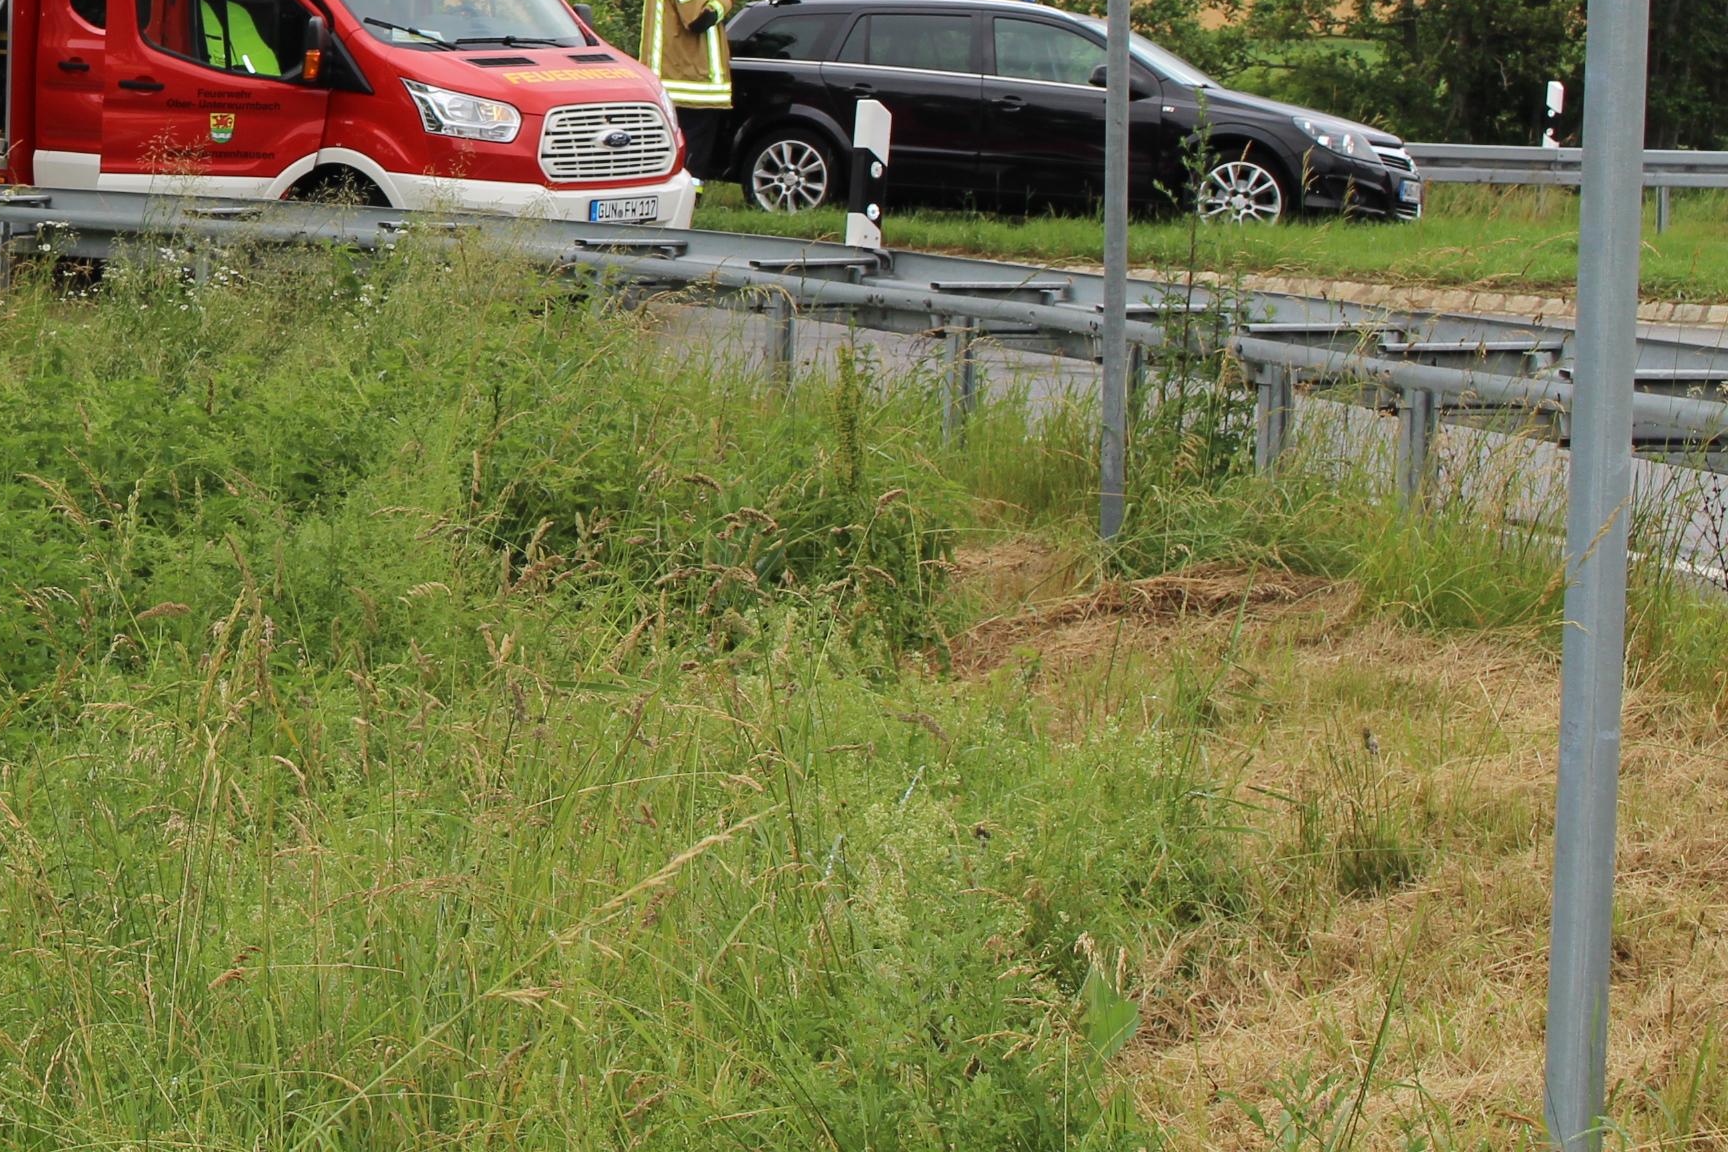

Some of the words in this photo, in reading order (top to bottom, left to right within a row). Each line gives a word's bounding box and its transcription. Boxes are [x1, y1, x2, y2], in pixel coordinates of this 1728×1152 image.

[502, 68, 643, 85] FEUERWEHR
[197, 88, 252, 99] Feuerwehr
[598, 201, 618, 219] GUN
[624, 201, 638, 218] FW
[639, 199, 656, 217] 117
